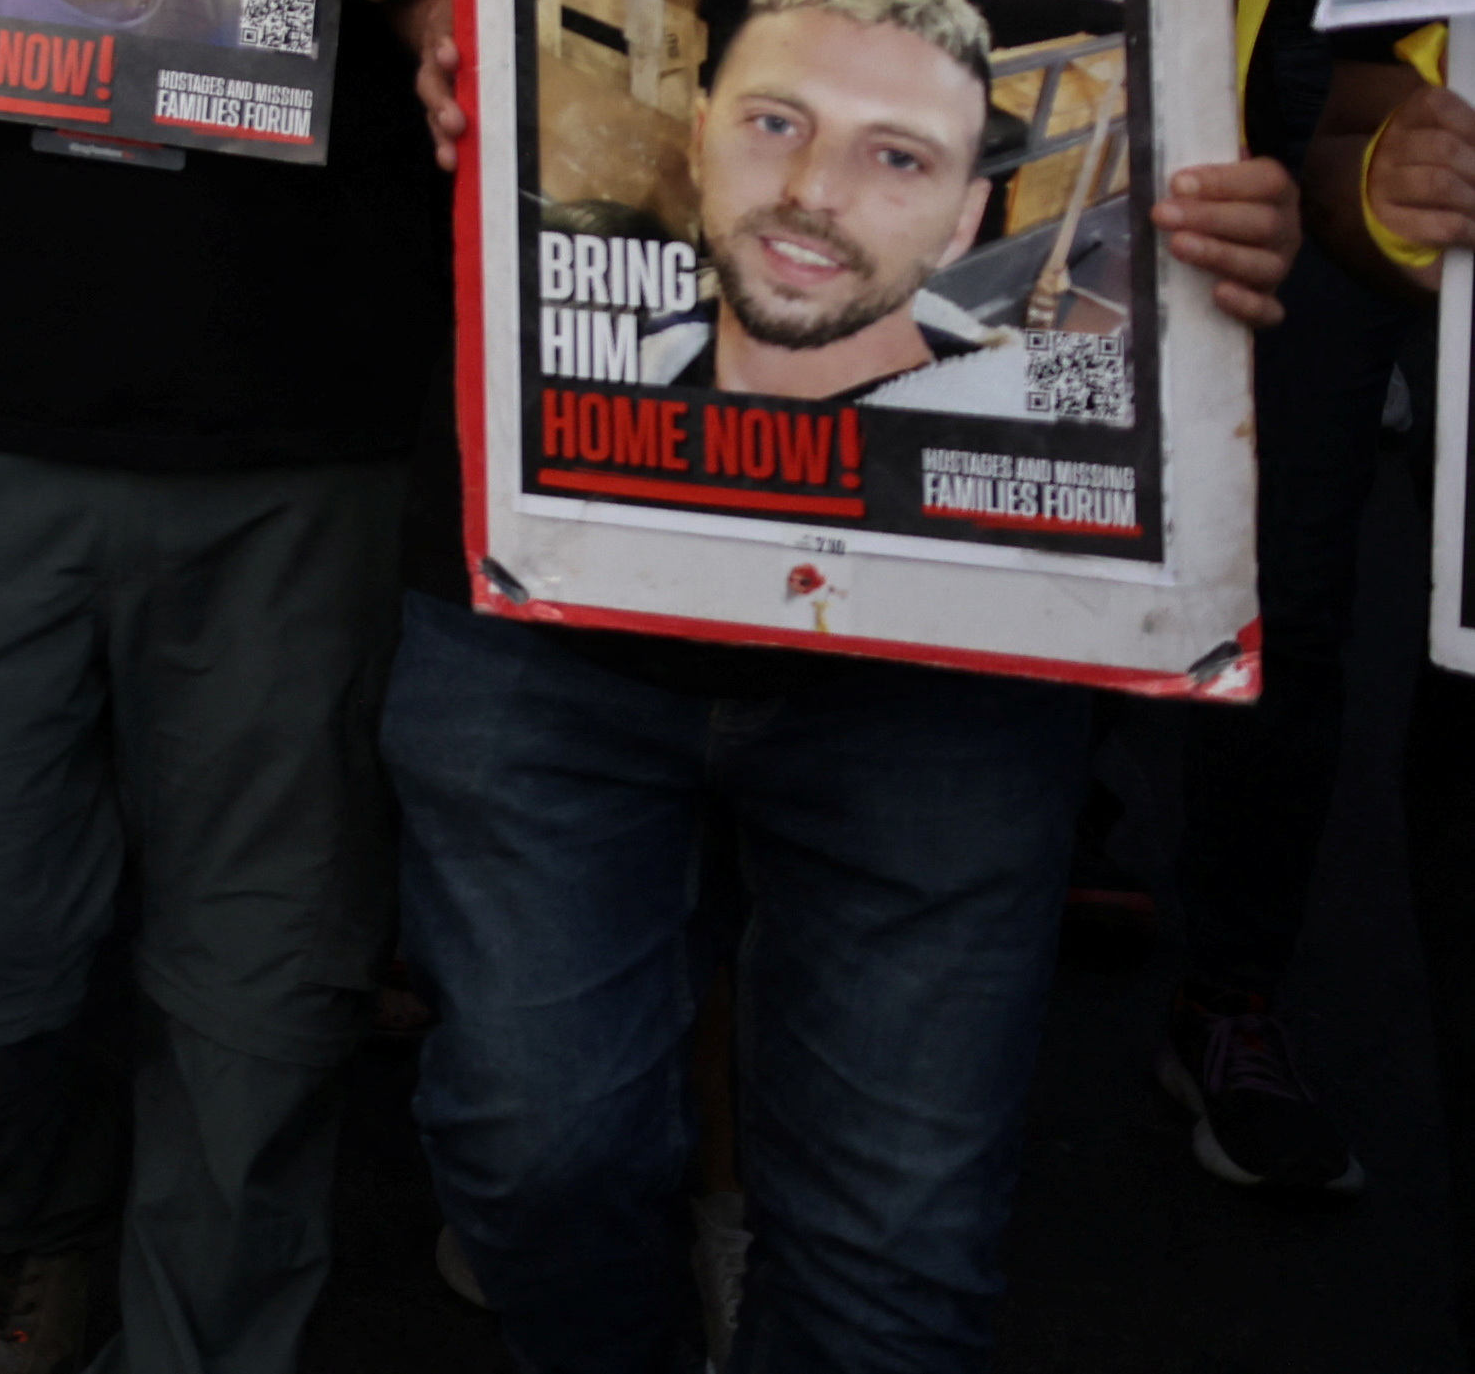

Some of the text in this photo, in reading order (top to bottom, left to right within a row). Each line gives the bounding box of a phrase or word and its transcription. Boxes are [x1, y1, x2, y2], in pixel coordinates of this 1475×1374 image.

[540, 231, 697, 312] BRING
[540, 305, 641, 384] HIM
[541, 389, 863, 491] HOME NOW!
